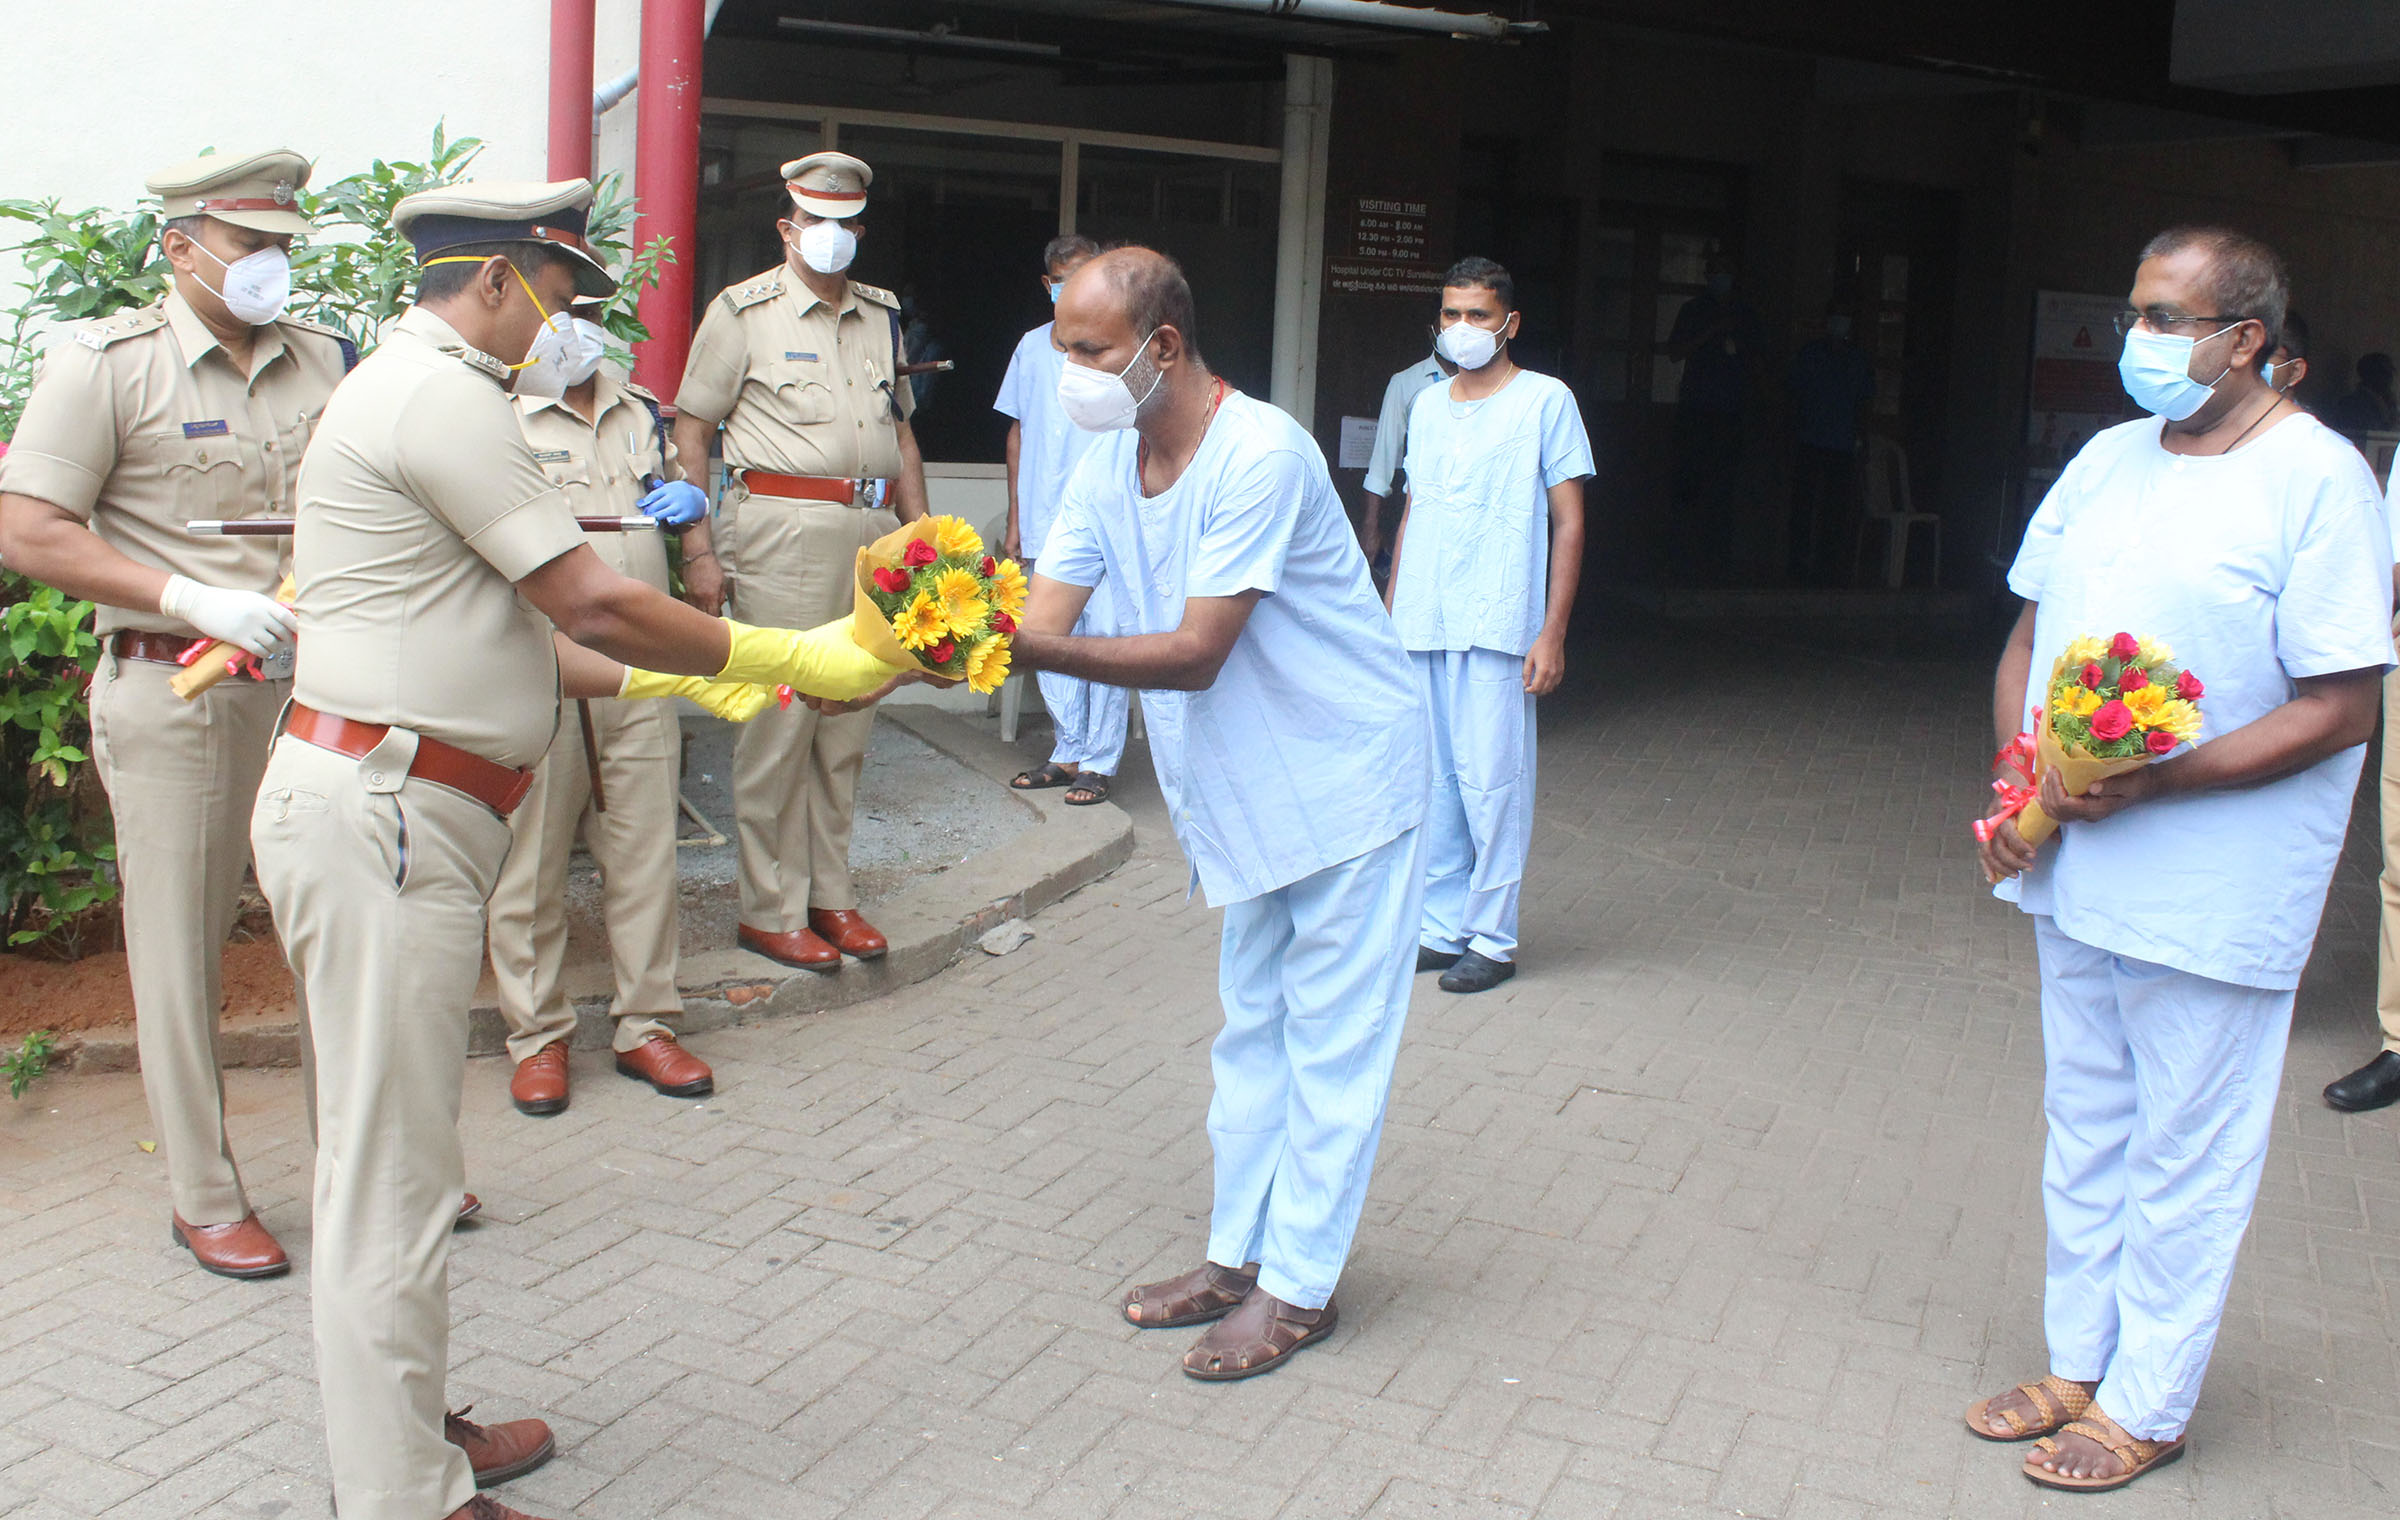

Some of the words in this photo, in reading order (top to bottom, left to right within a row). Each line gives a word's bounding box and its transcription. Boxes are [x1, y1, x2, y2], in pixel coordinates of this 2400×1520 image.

[1359, 199, 1401, 212] VISITING
[1404, 203, 1426, 214] TIME
[1358, 232, 1379, 242] 12.30
[1396, 235, 1413, 244] 2.00
[1359, 246, 1376, 256] 5.00
[1392, 249, 1408, 258] 9.00
[1331, 264, 1358, 275] Hospital
[1360, 267, 1381, 277] Under
[1396, 269, 1405, 278] TV
